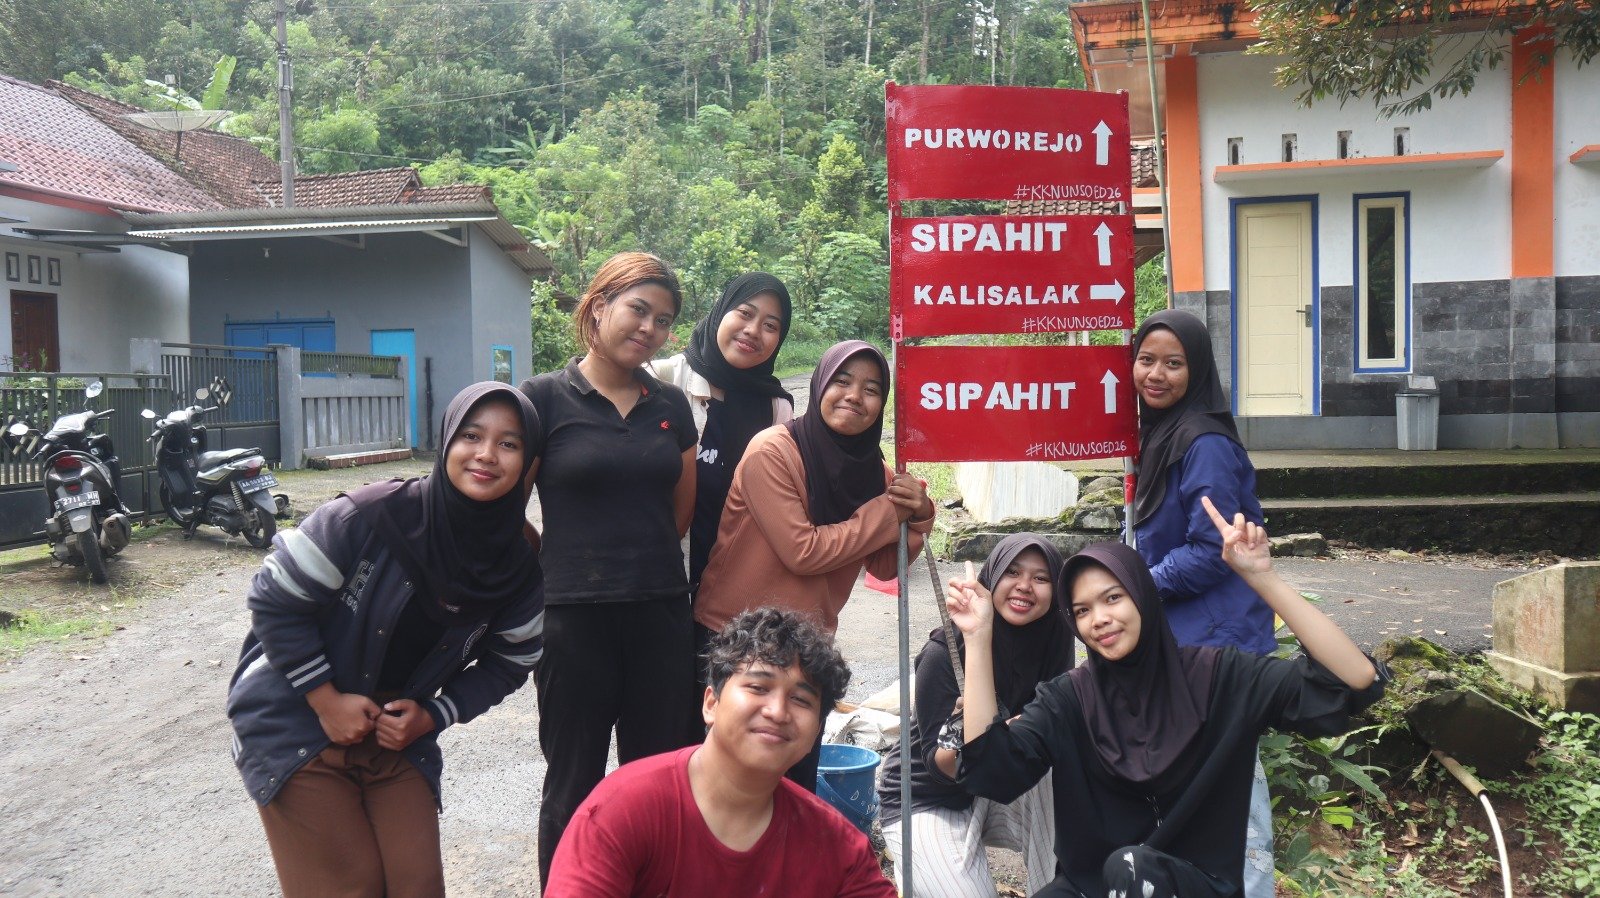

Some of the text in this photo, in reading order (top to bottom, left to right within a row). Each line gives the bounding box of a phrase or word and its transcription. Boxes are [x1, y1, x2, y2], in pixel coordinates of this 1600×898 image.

[905, 128, 1082, 152] PURWOREJO
[1014, 185, 1121, 199] #KKNUNSOED26
[911, 223, 1067, 252] SIPAHIT
[914, 285, 1079, 305] KALISALAK
[1021, 316, 1123, 332] #KKNUNSOED26
[920, 382, 1076, 410] SIPAHIT
[1026, 441, 1127, 458] #KKNUNSOED26
